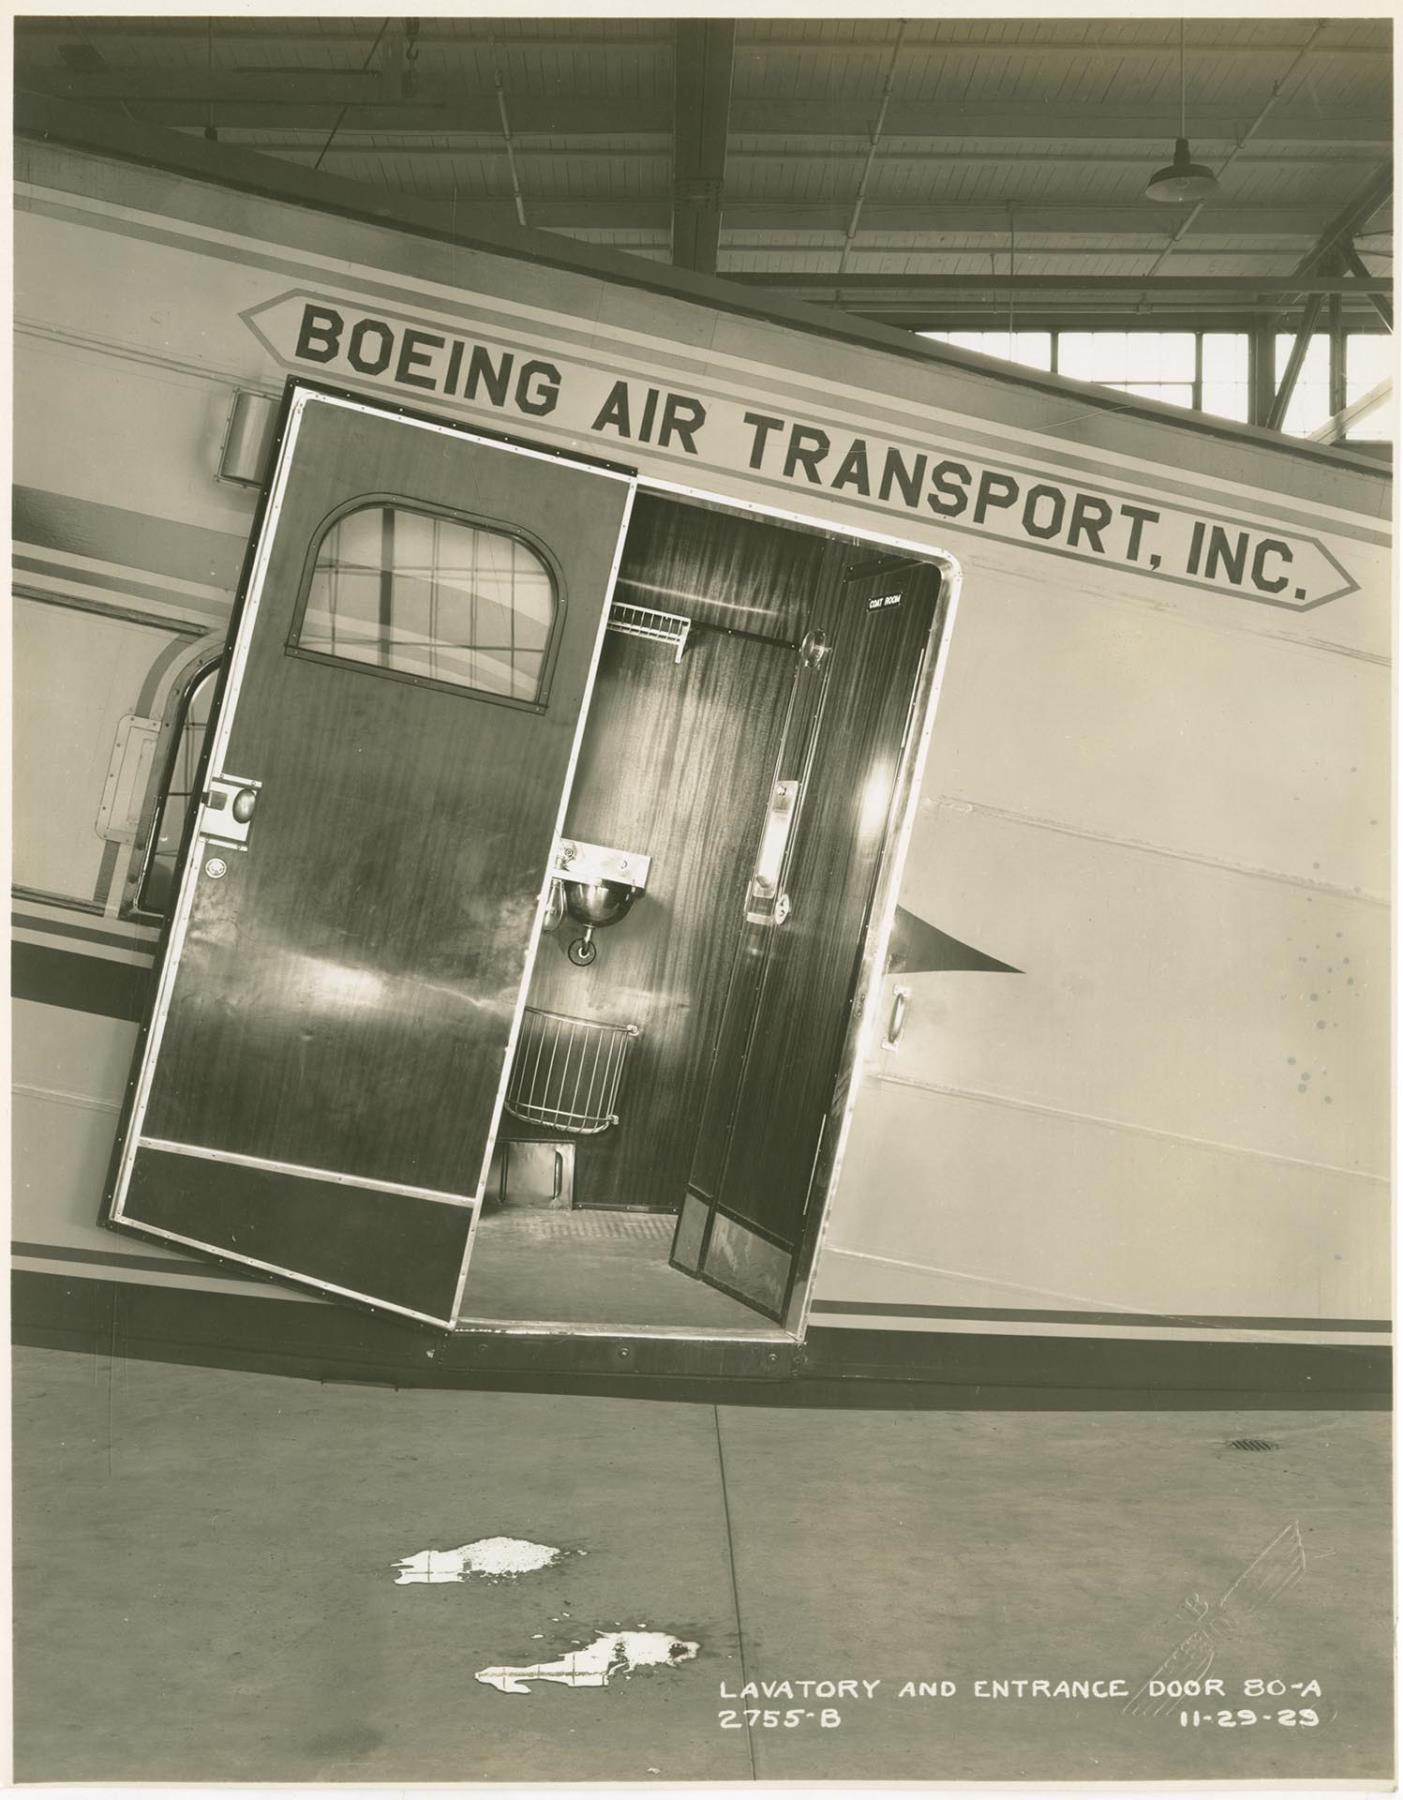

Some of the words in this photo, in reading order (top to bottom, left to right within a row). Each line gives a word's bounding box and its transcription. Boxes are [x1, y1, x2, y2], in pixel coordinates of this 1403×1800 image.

[295, 303, 561, 417] BOEING
[591, 381, 707, 454] AIR
[743, 412, 1160, 570] TRANSPORT,
[1186, 521, 1307, 600] INC.
[869, 597, 884, 609] COAT
[884, 594, 901, 606] ROOM
